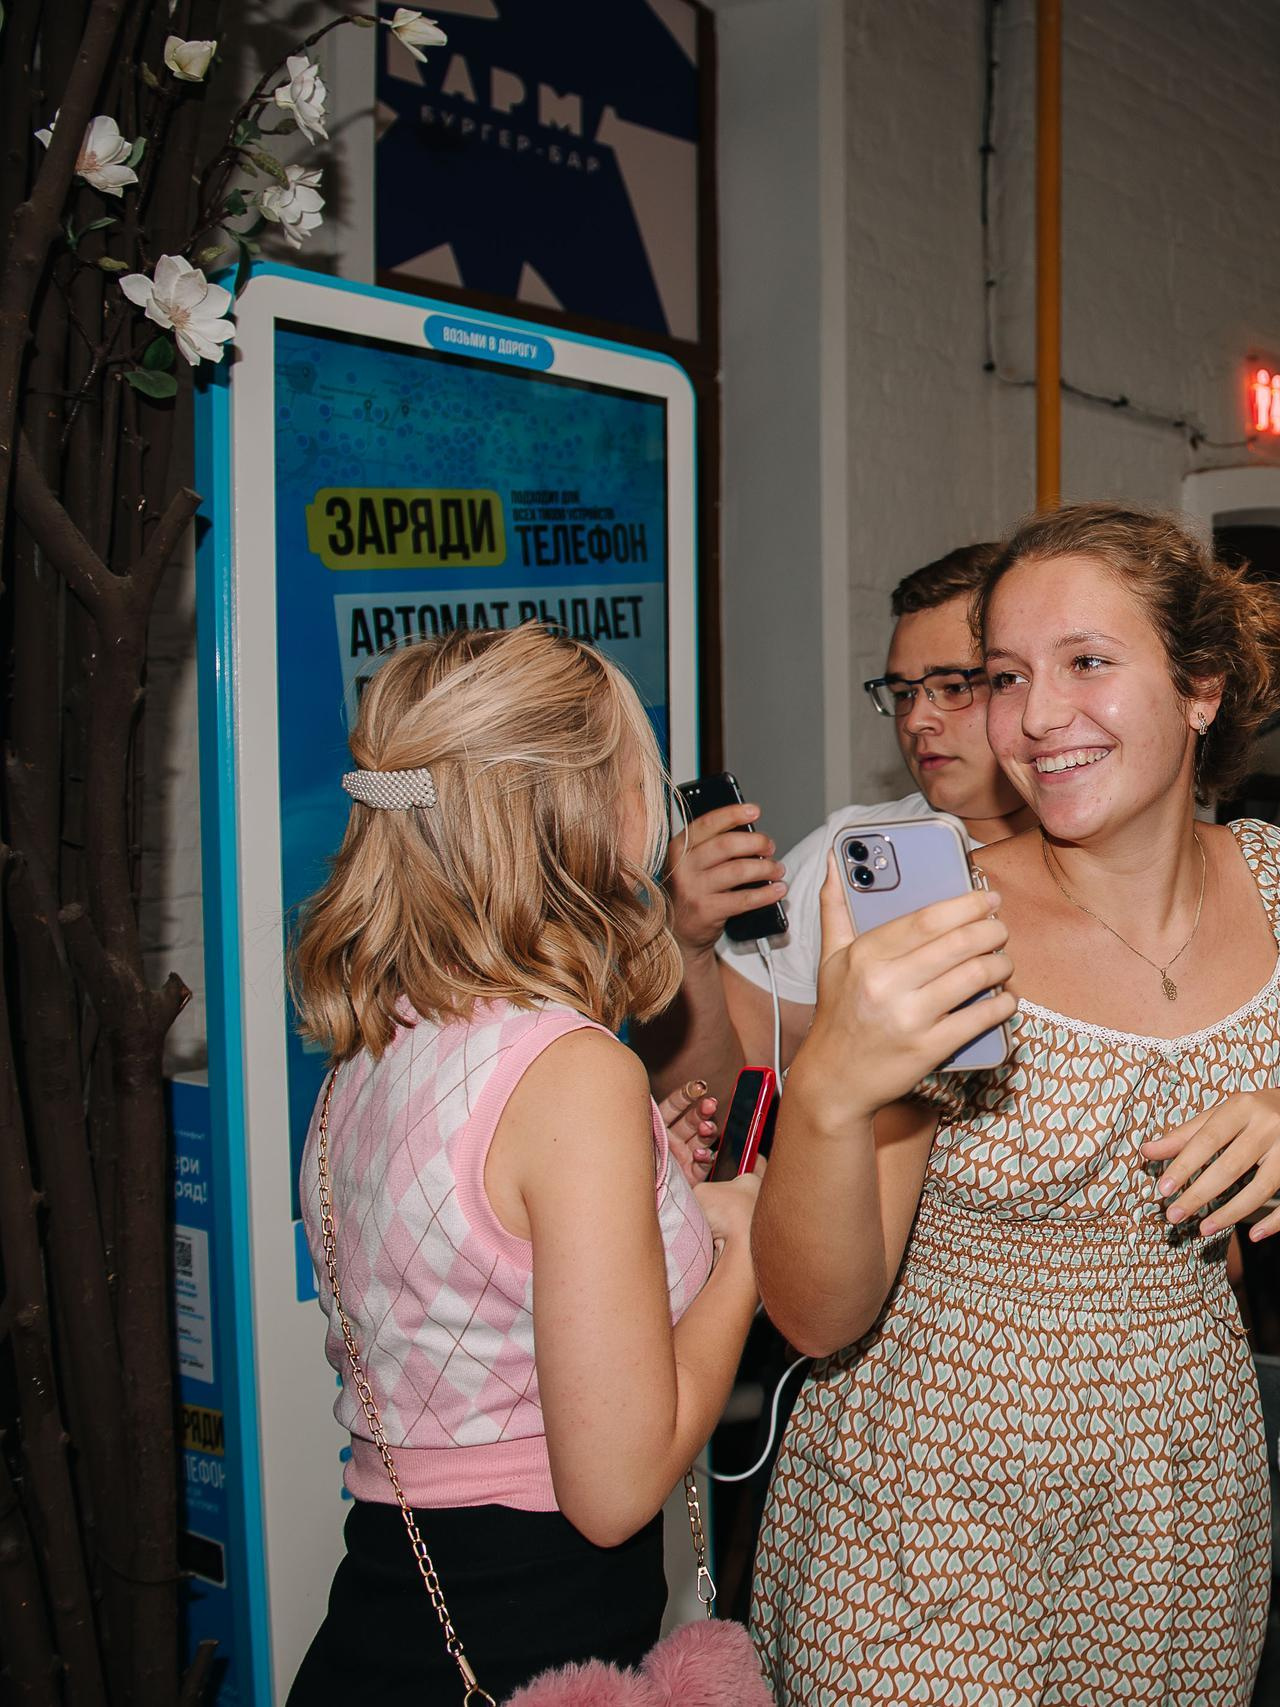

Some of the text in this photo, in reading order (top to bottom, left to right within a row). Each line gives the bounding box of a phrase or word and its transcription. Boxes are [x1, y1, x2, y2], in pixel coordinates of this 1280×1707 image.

[420, 104, 600, 173] БУРГЕР-БАР
[443, 326, 538, 359] ВОЗЬМИ В ДОРОГУ
[325, 496, 648, 567] ЗАРЯДИ ТЕЛЕФОН
